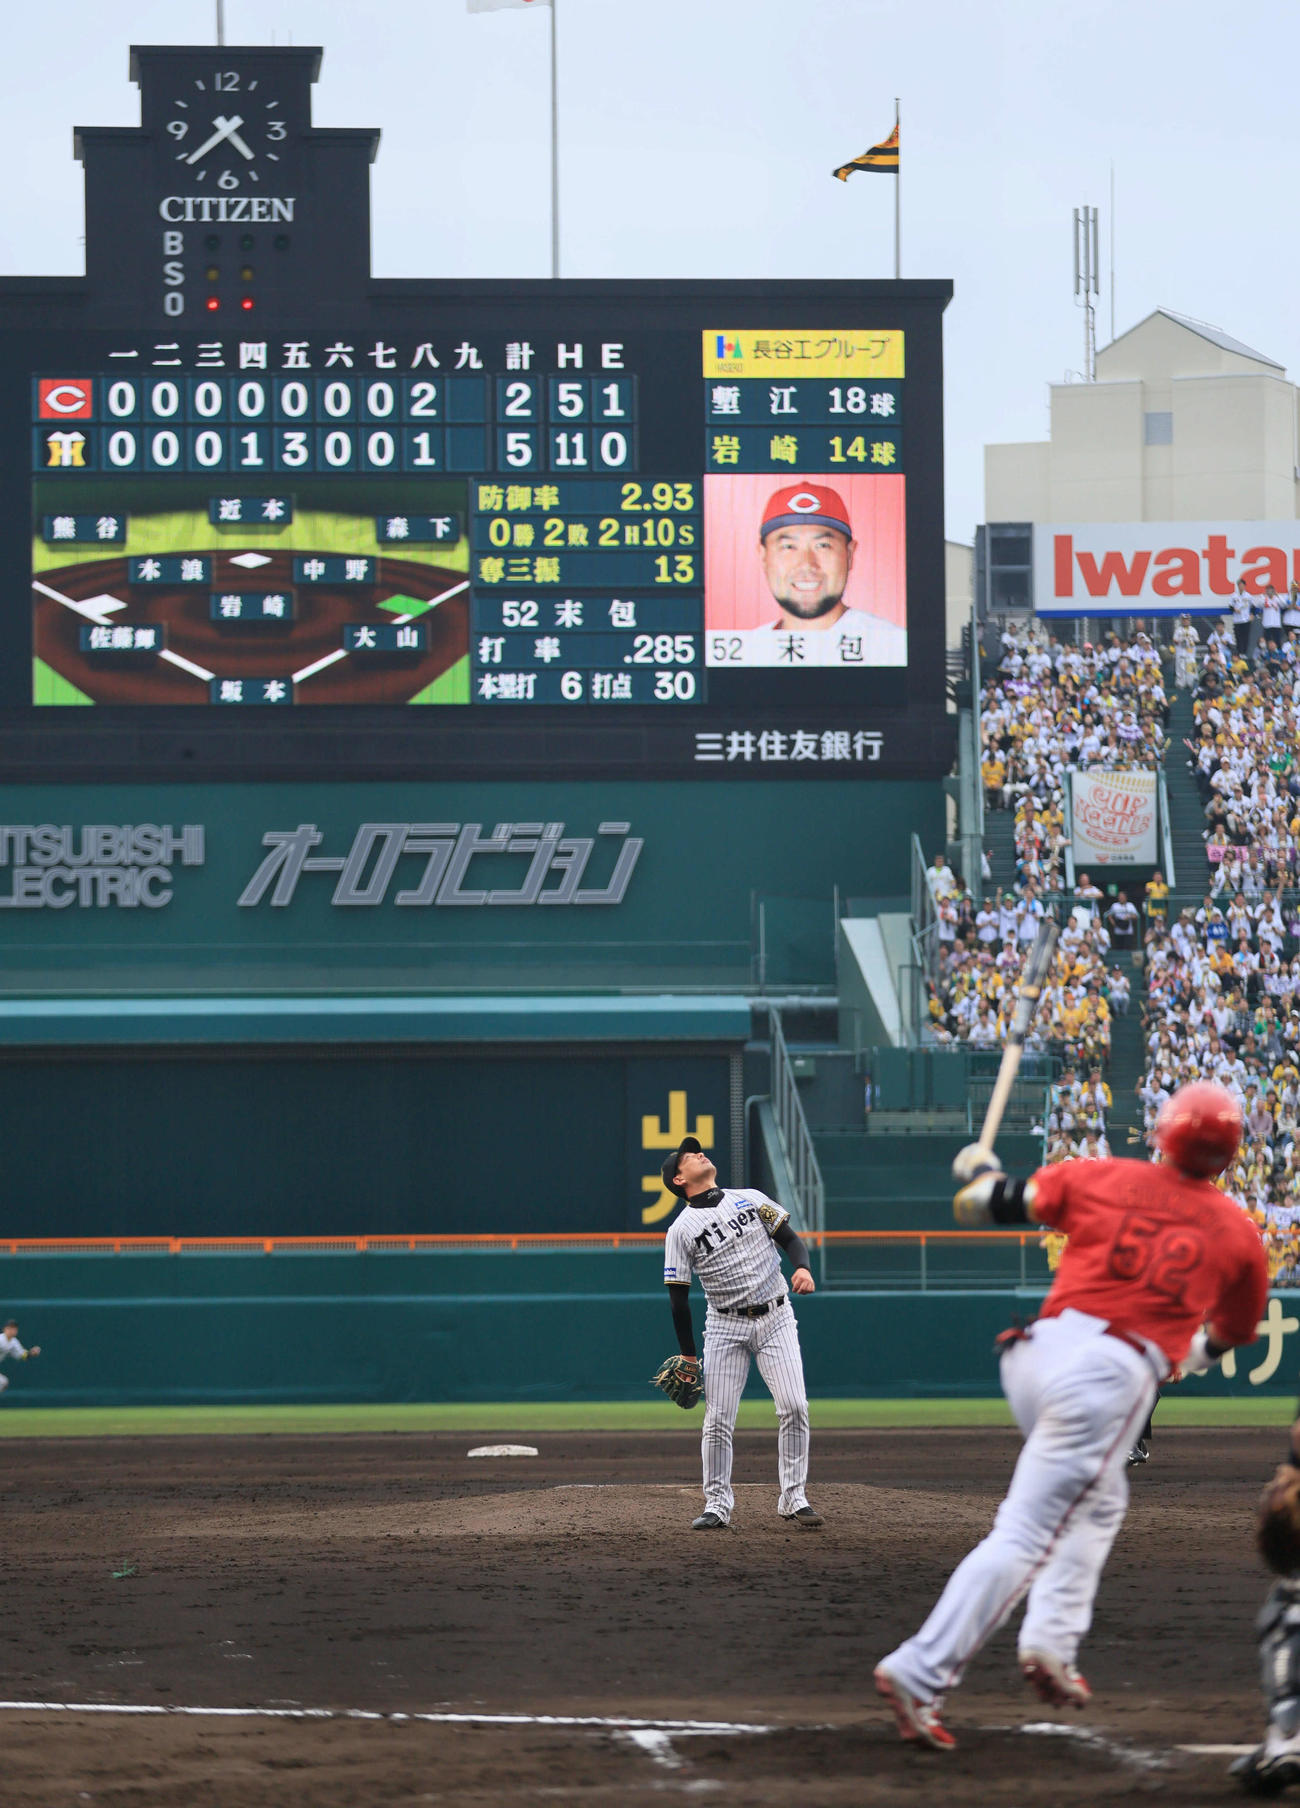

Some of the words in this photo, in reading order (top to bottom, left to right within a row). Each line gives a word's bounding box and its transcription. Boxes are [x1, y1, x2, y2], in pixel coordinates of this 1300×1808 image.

[215, 71, 240, 91] 12
[166, 121, 188, 140] 9
[266, 122, 287, 140] 3
[217, 170, 239, 189] 6
[159, 197, 296, 222] CITIZEN
[163, 231, 184, 255] B
[163, 261, 185, 286] S
[152, 342, 182, 366] 二
[195, 342, 225, 367] 三
[239, 342, 267, 369] 四
[281, 341, 311, 369] 五
[324, 342, 354, 369] 六
[368, 341, 397, 369] 七
[410, 343, 440, 369] 八
[454, 342, 483, 370] 九
[505, 342, 535, 370] 計
[557, 343, 583, 369] H
[601, 343, 624, 369] E
[108, 381, 135, 417] 0
[152, 381, 179, 417] 0
[195, 381, 222, 417] 0
[238, 381, 265, 417] 0
[281, 381, 308, 417] 0
[324, 381, 351, 417] 0
[367, 381, 394, 417] 0
[410, 382, 437, 417] 2
[505, 382, 532, 417] 2
[557, 383, 584, 417] 5
[602, 383, 625, 417] 1
[828, 386, 897, 417] 18球
[108, 431, 135, 467] 0
[152, 431, 179, 467] 0
[195, 431, 222, 467] 0
[241, 431, 264, 466] 1
[281, 432, 309, 467] 3
[324, 431, 351, 467] 0
[367, 431, 394, 467] 0
[413, 432, 436, 466] 1
[506, 433, 532, 467] 5
[555, 432, 588, 466] 11
[601, 431, 628, 466] 0
[829, 435, 896, 466] 14球
[478, 484, 560, 511] 防御率
[621, 482, 695, 511] 2.93
[654, 555, 695, 584] 13
[1054, 533, 1300, 597] Iwata
[502, 600, 539, 628] 52
[353, 625, 419, 648] 大山
[478, 636, 561, 664] 打率
[623, 634, 696, 665] .285
[713, 637, 743, 661] 52
[560, 670, 583, 701] 6
[592, 672, 633, 699] 打点
[653, 670, 696, 701] 30
[694, 730, 884, 761] 三井住友銀行
[1107, 1212, 1204, 1300] 52
